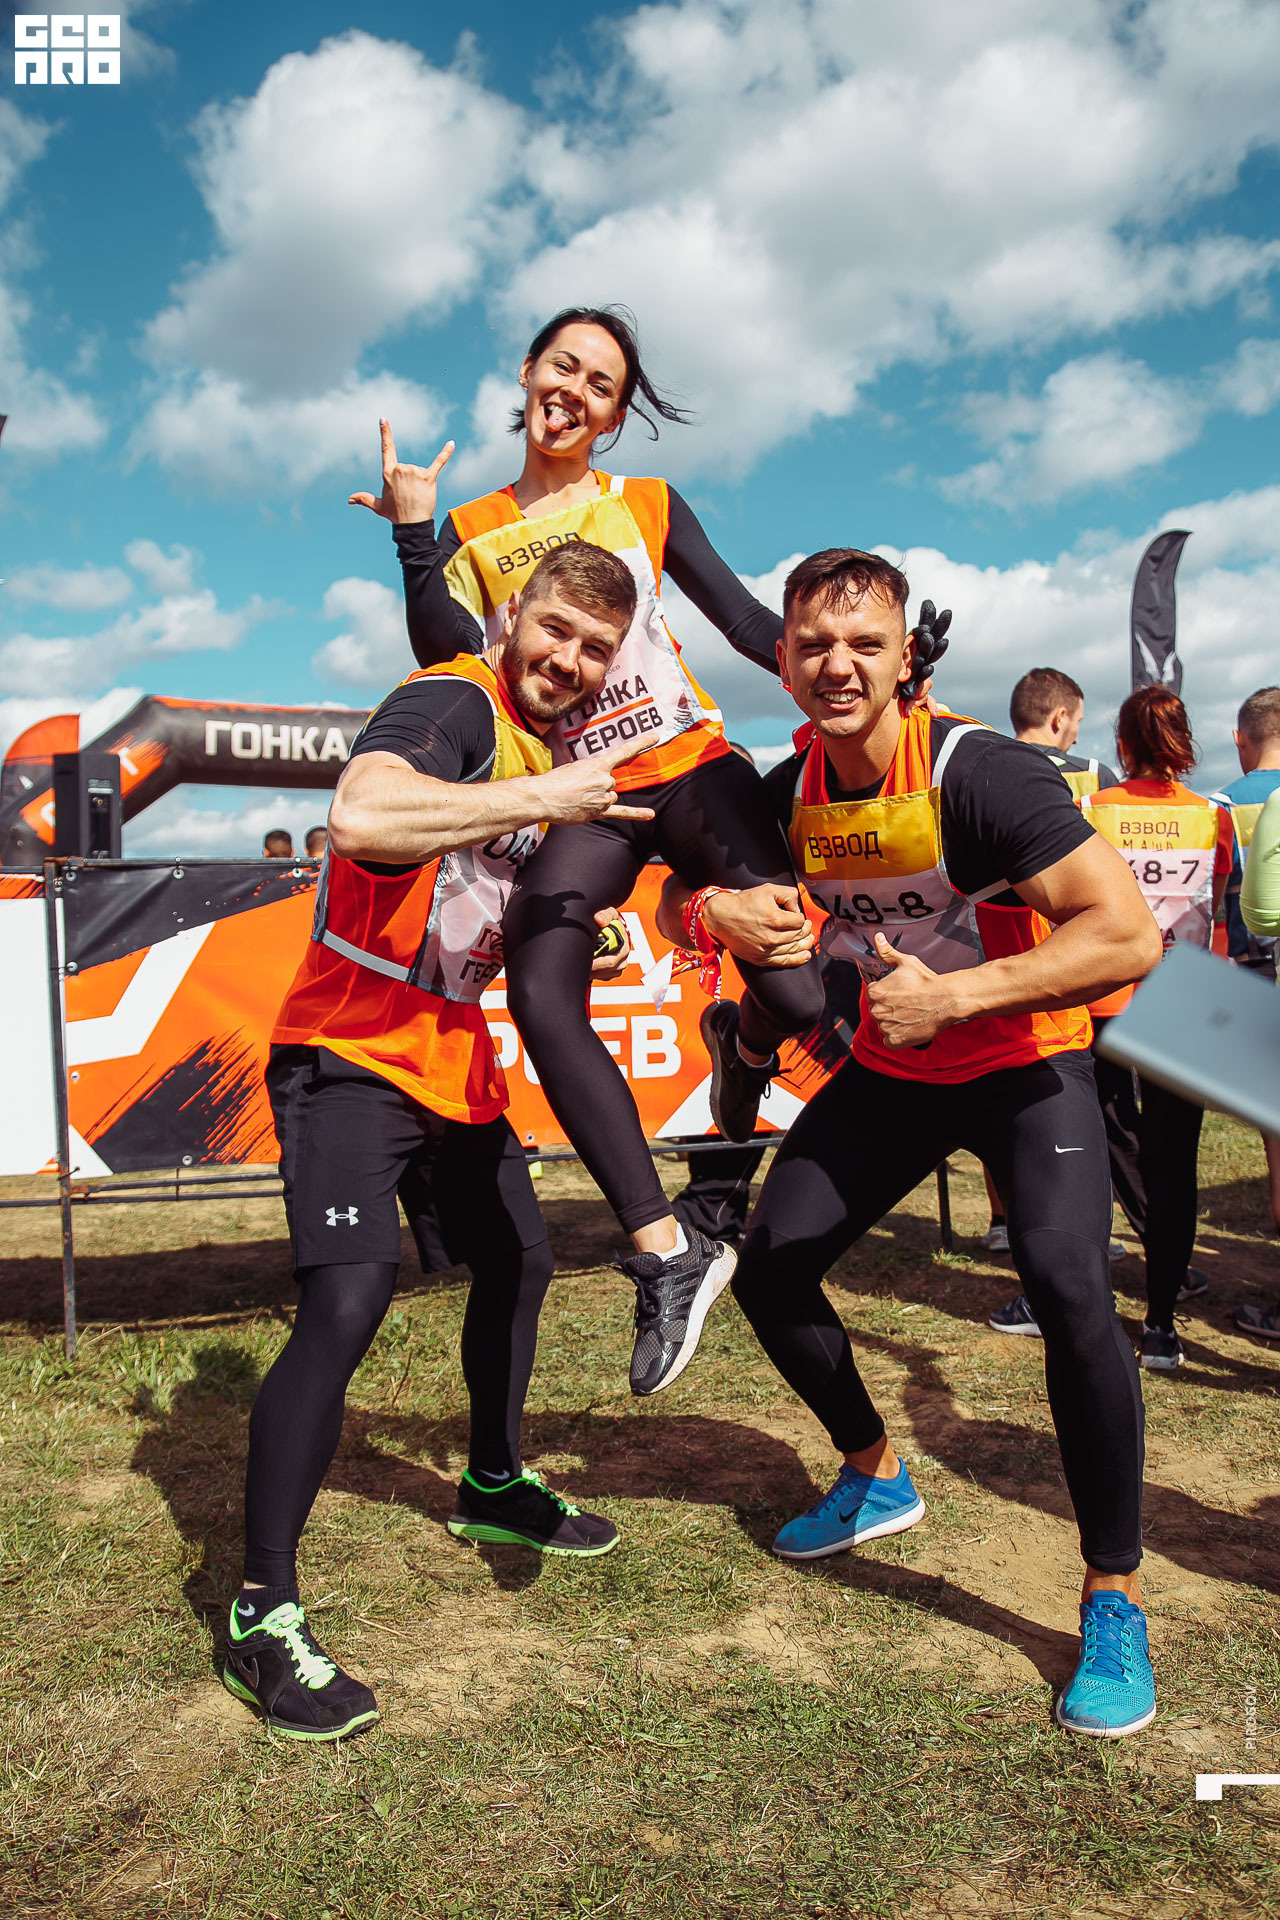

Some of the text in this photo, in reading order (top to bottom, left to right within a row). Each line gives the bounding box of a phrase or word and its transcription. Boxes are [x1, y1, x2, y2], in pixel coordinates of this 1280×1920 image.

[205, 719, 350, 762] ГОНКА
[566, 706, 664, 762] ГЕРОЕВ
[808, 830, 884, 860] ВЗВОД
[1120, 821, 1180, 838] ВЗВОД
